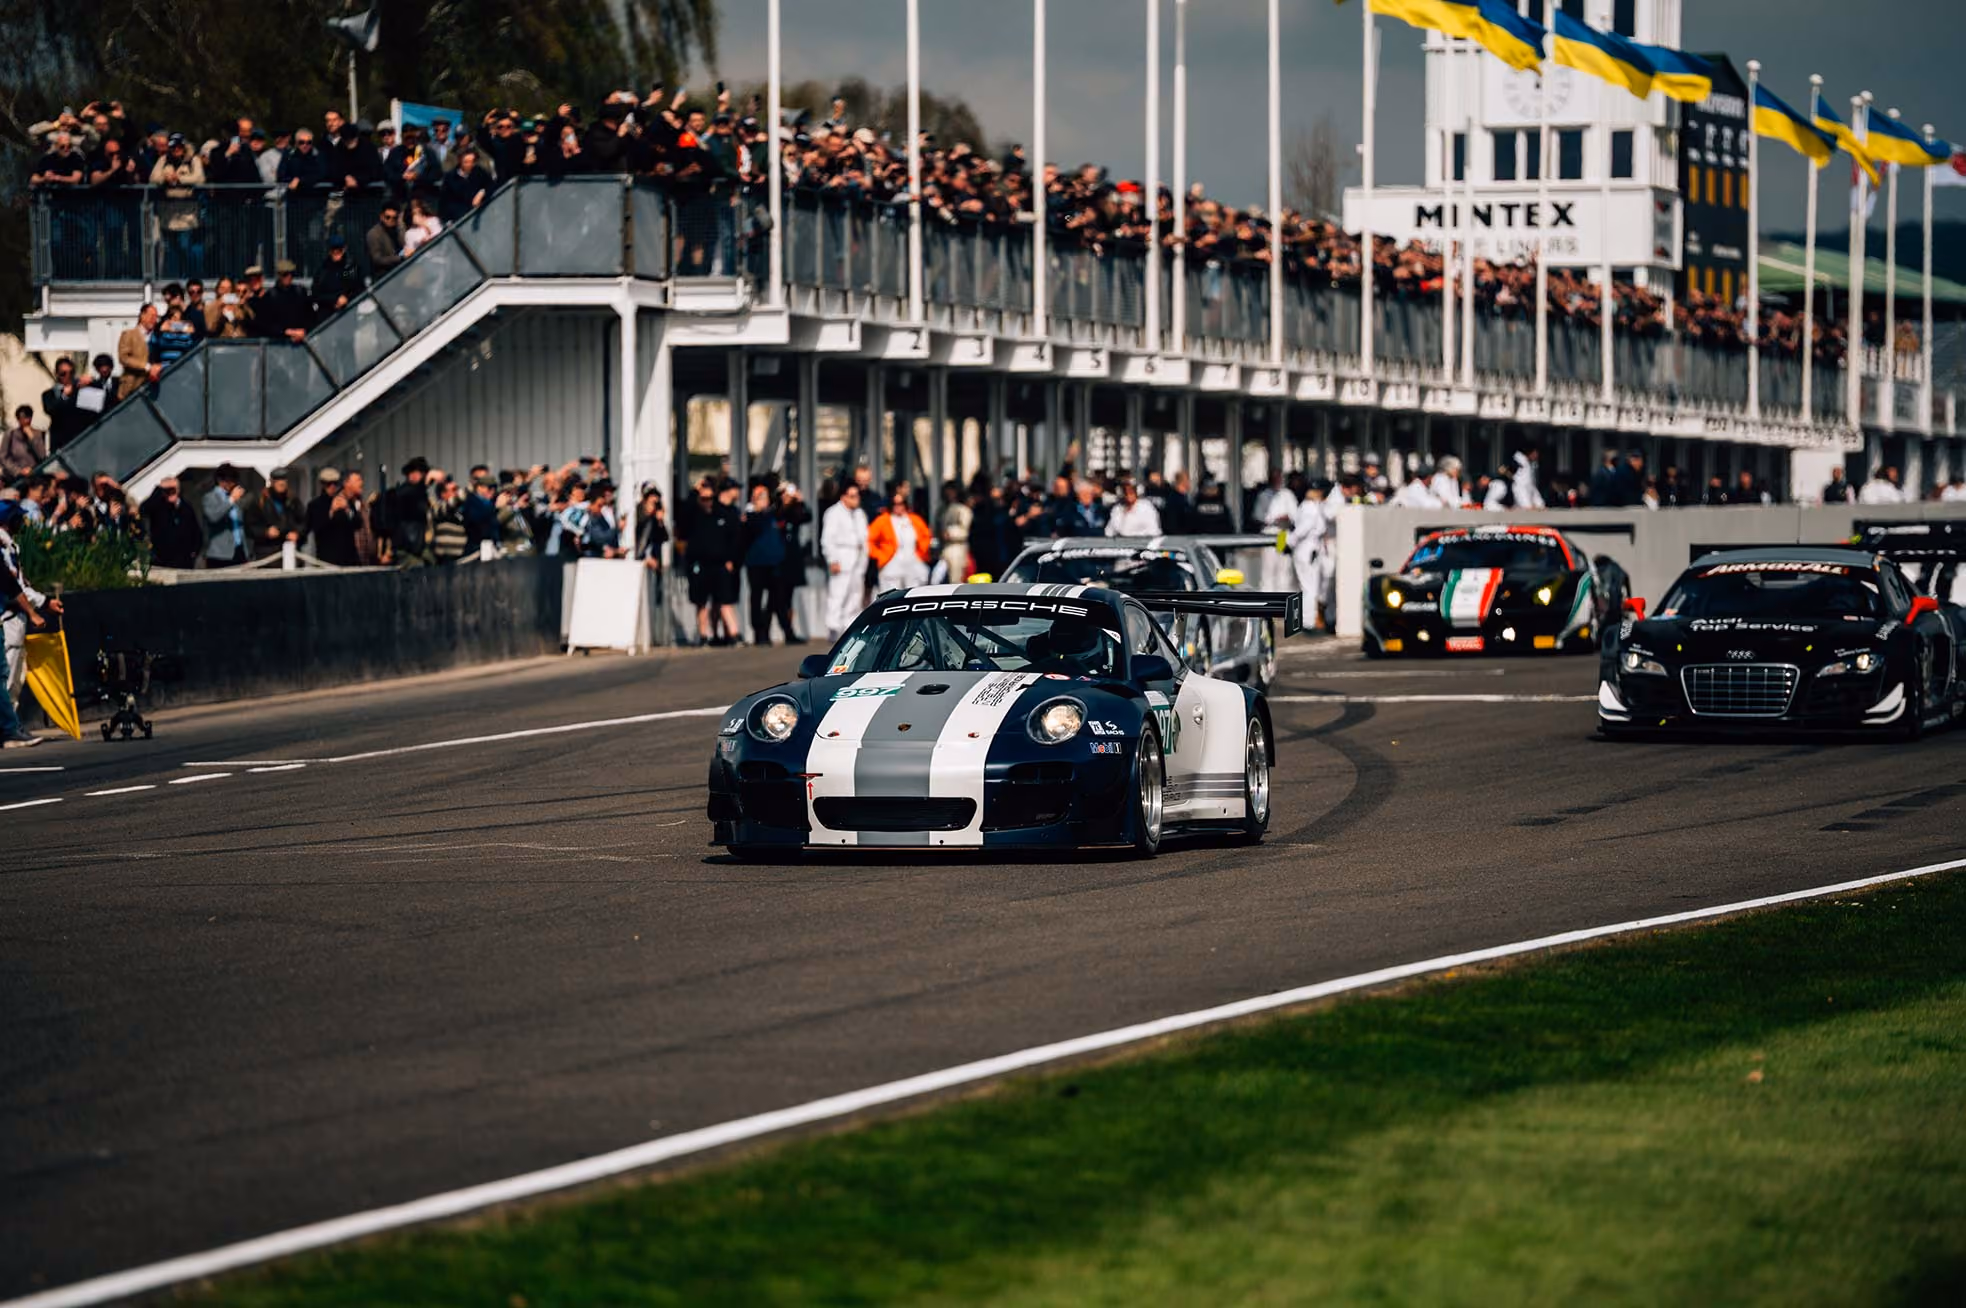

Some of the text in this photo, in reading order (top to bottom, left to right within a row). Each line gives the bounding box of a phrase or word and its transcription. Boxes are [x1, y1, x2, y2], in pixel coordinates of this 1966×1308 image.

[1416, 203, 1575, 228] MINTEX
[909, 328, 921, 350] 2
[973, 336, 985, 358] 3
[1090, 349, 1101, 369] 5
[1143, 354, 1156, 374] 6
[882, 600, 1088, 617] PORSCHE
[1690, 623, 1729, 632] Top
[1691, 617, 1742, 625] Audi
[835, 686, 901, 699] 997
[1153, 709, 1171, 750] 97
